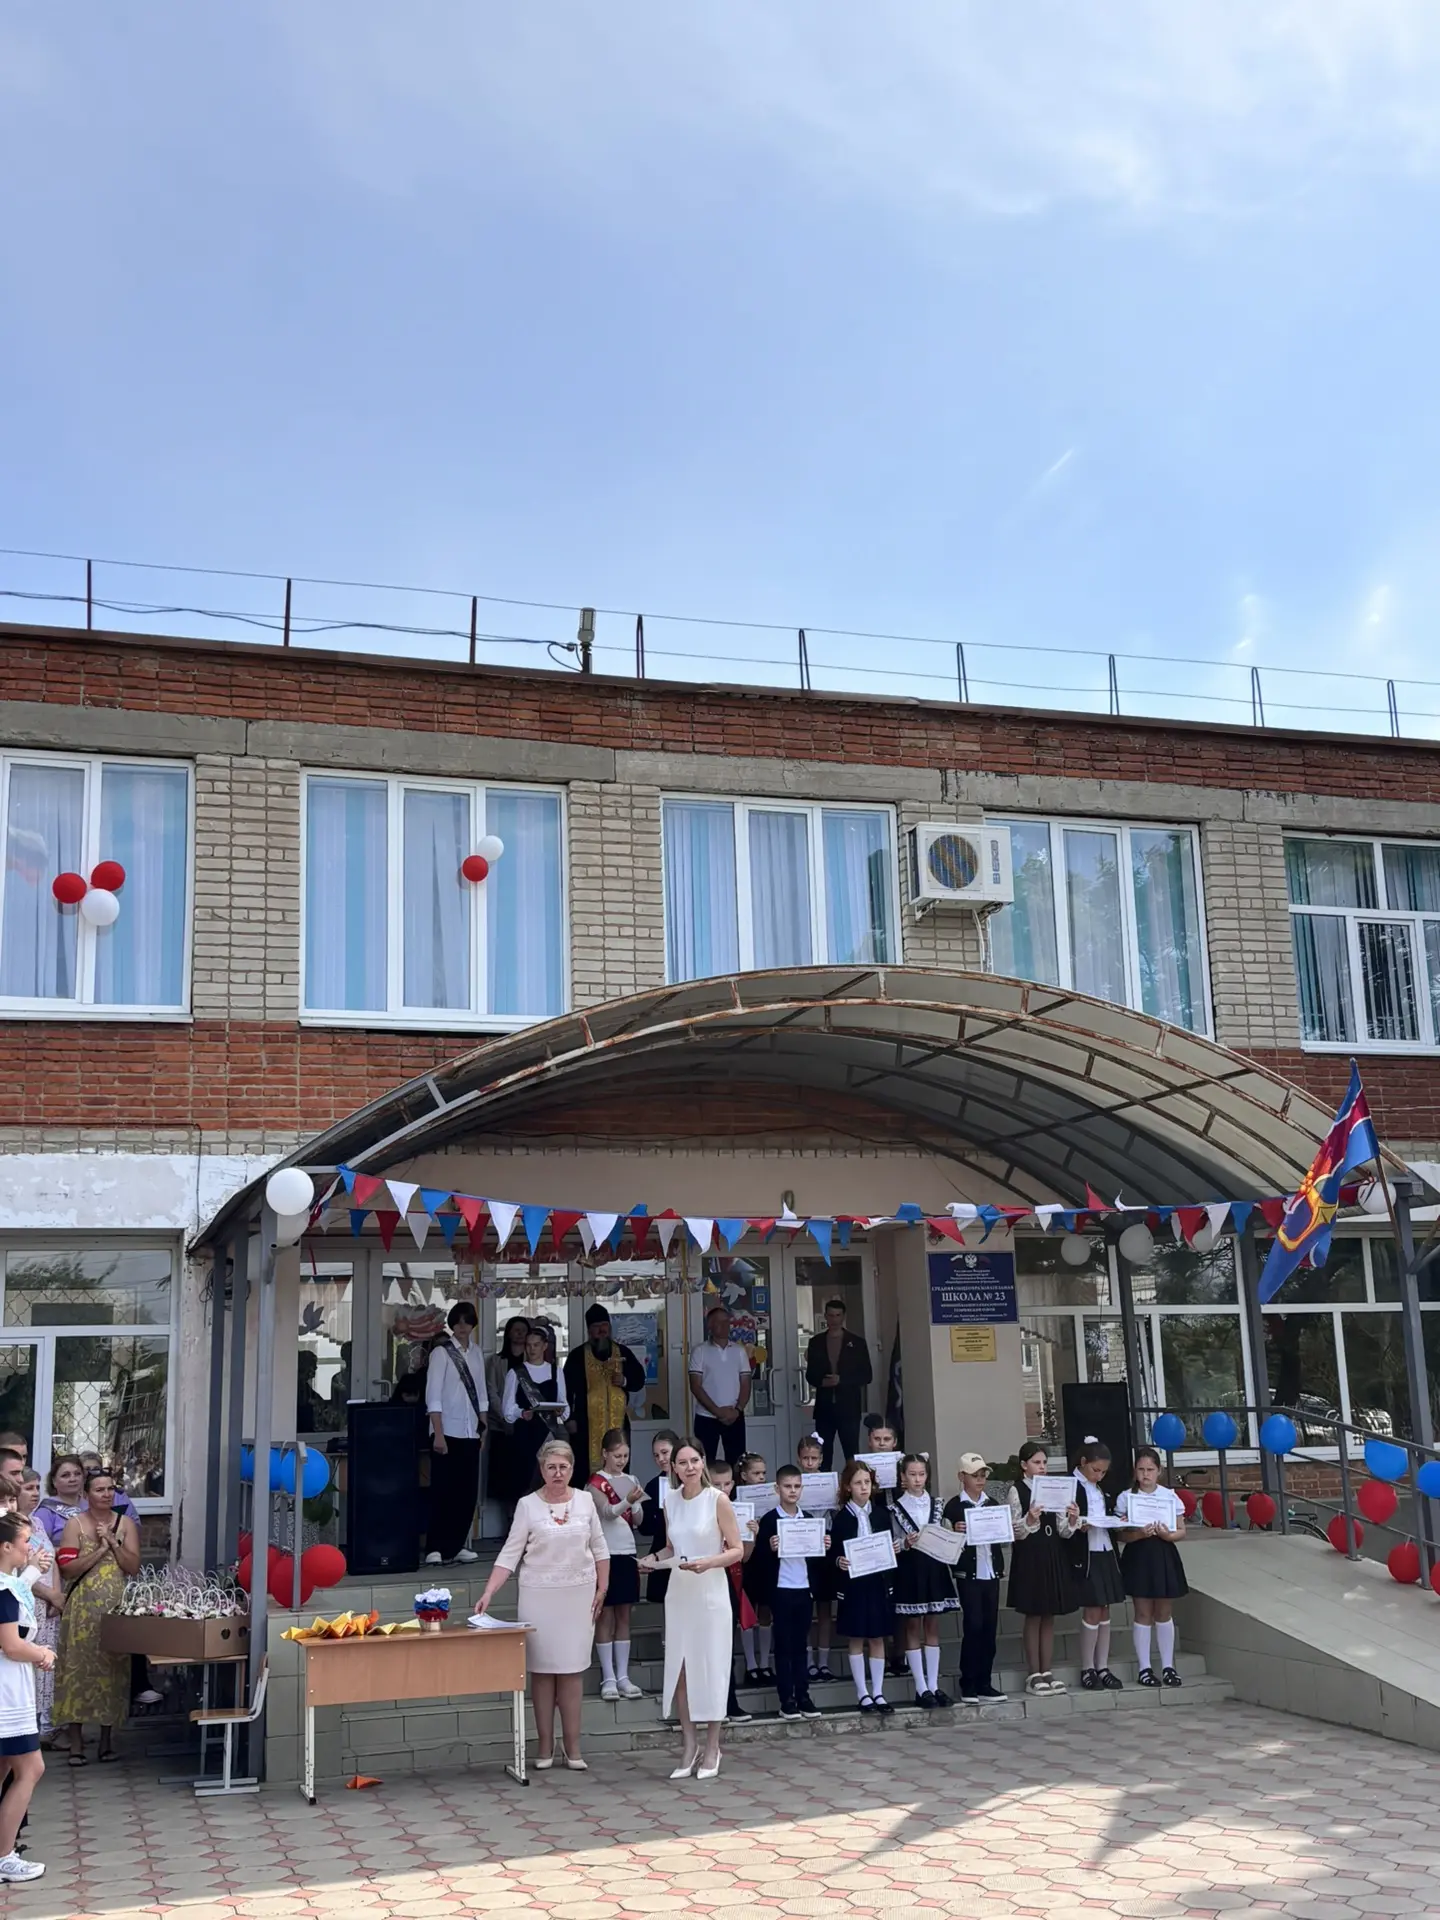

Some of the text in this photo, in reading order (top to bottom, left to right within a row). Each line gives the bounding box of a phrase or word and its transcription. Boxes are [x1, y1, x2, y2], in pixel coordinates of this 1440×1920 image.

[942, 1291, 1006, 1302] ШКОЛА № 23
